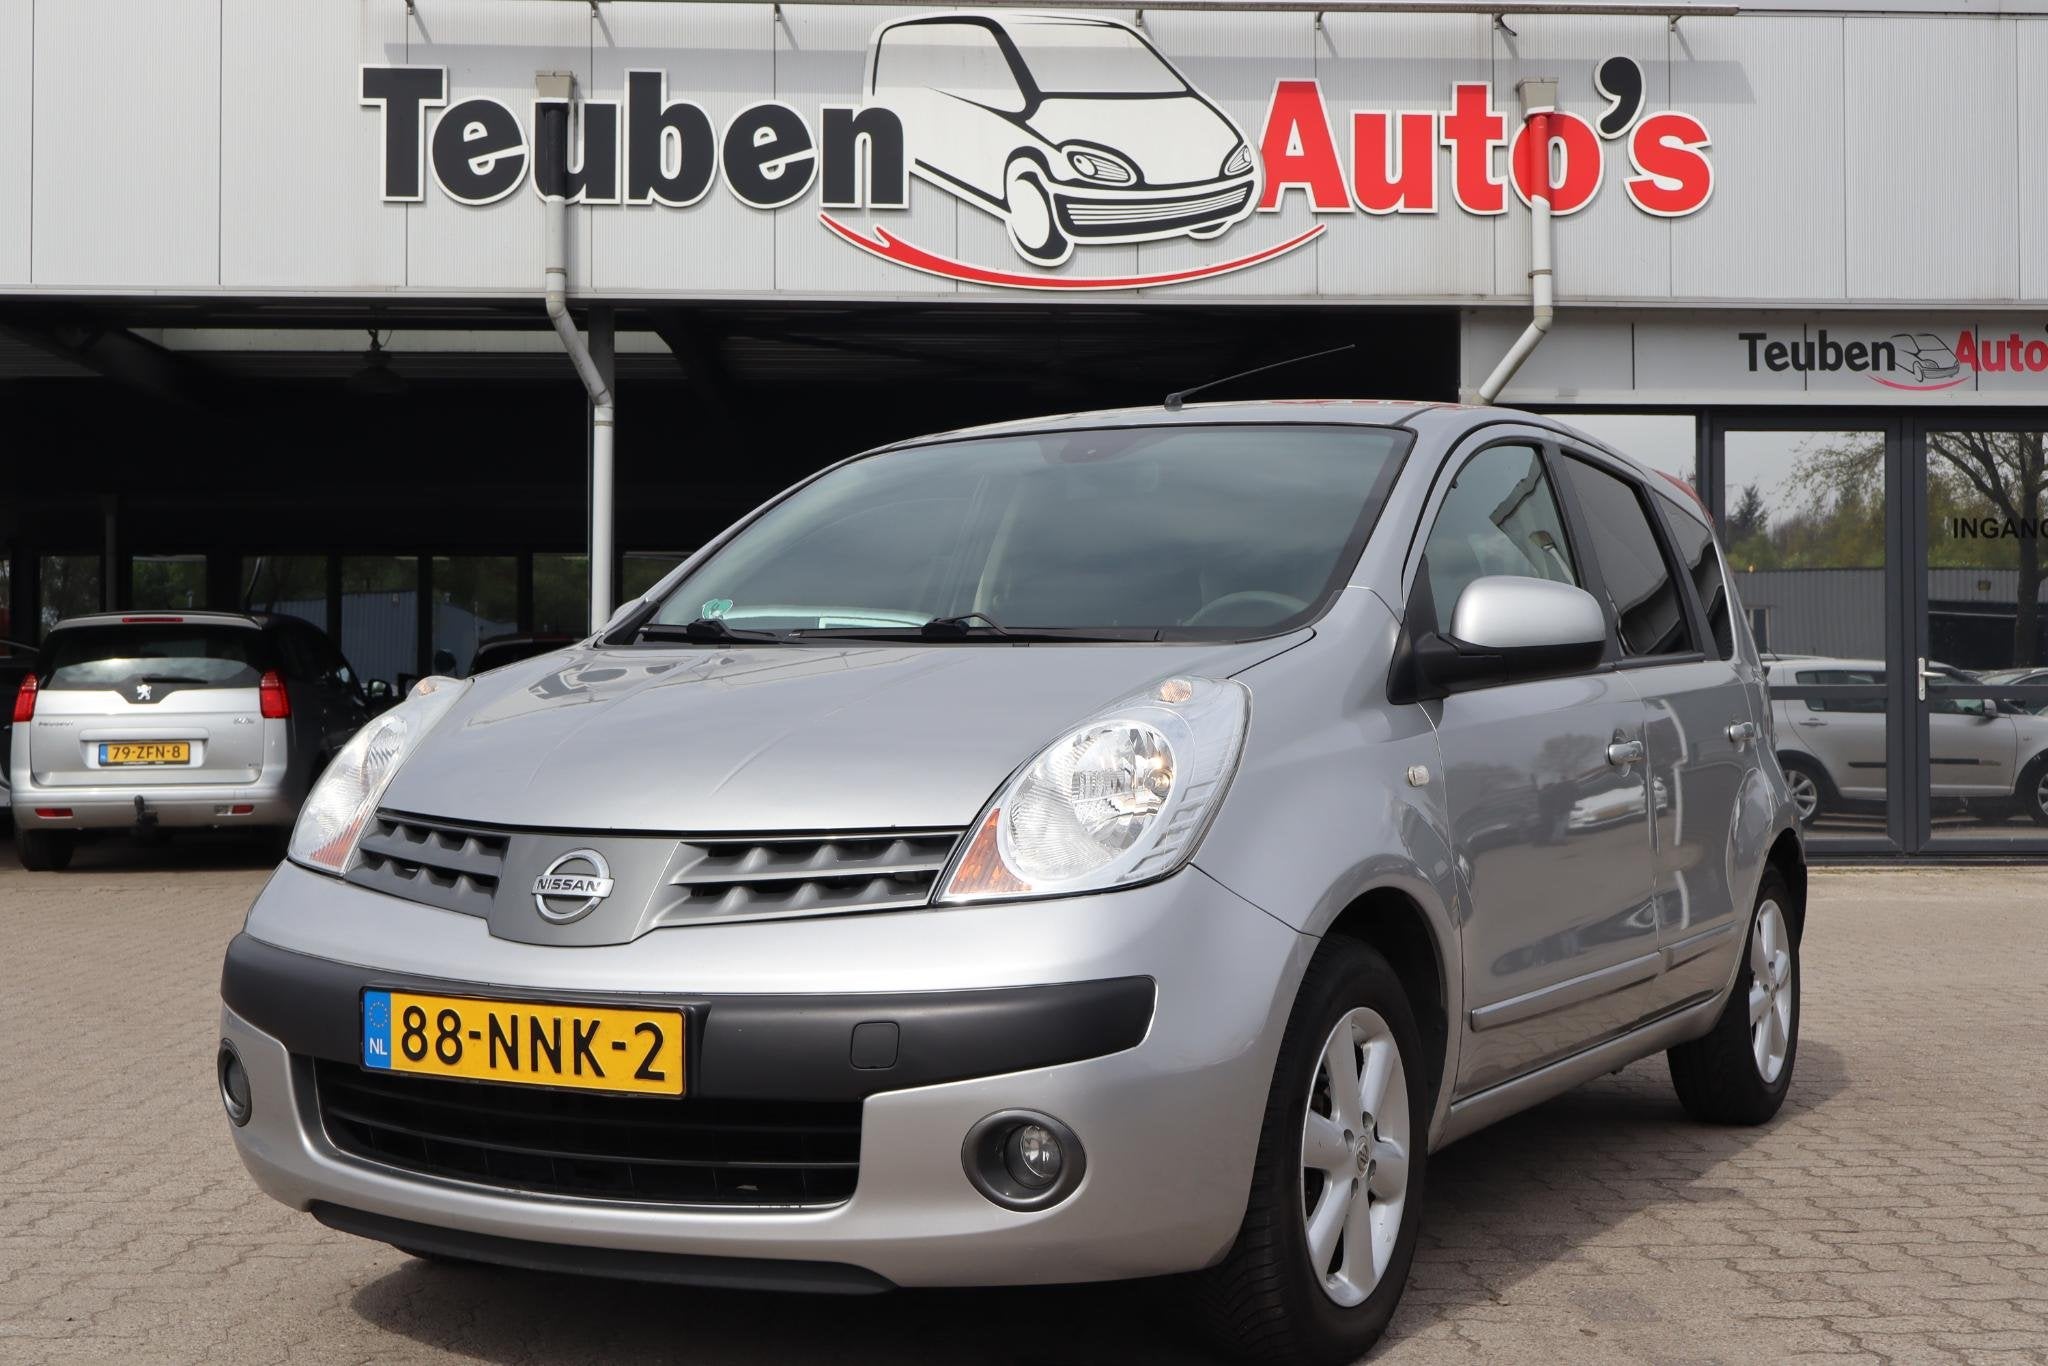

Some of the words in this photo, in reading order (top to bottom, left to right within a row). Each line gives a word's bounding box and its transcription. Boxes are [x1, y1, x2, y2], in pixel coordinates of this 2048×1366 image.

[361, 66, 905, 207] Teuben
[1258, 56, 1712, 215] Auto's
[1738, 329, 1896, 372] Teuben
[1956, 324, 2048, 373] Auto
[112, 745, 181, 760] 79-ZFN-8
[537, 879, 602, 892] NISSAN
[369, 1038, 388, 1056] NL
[401, 1005, 666, 1082] 88-NNK-2
